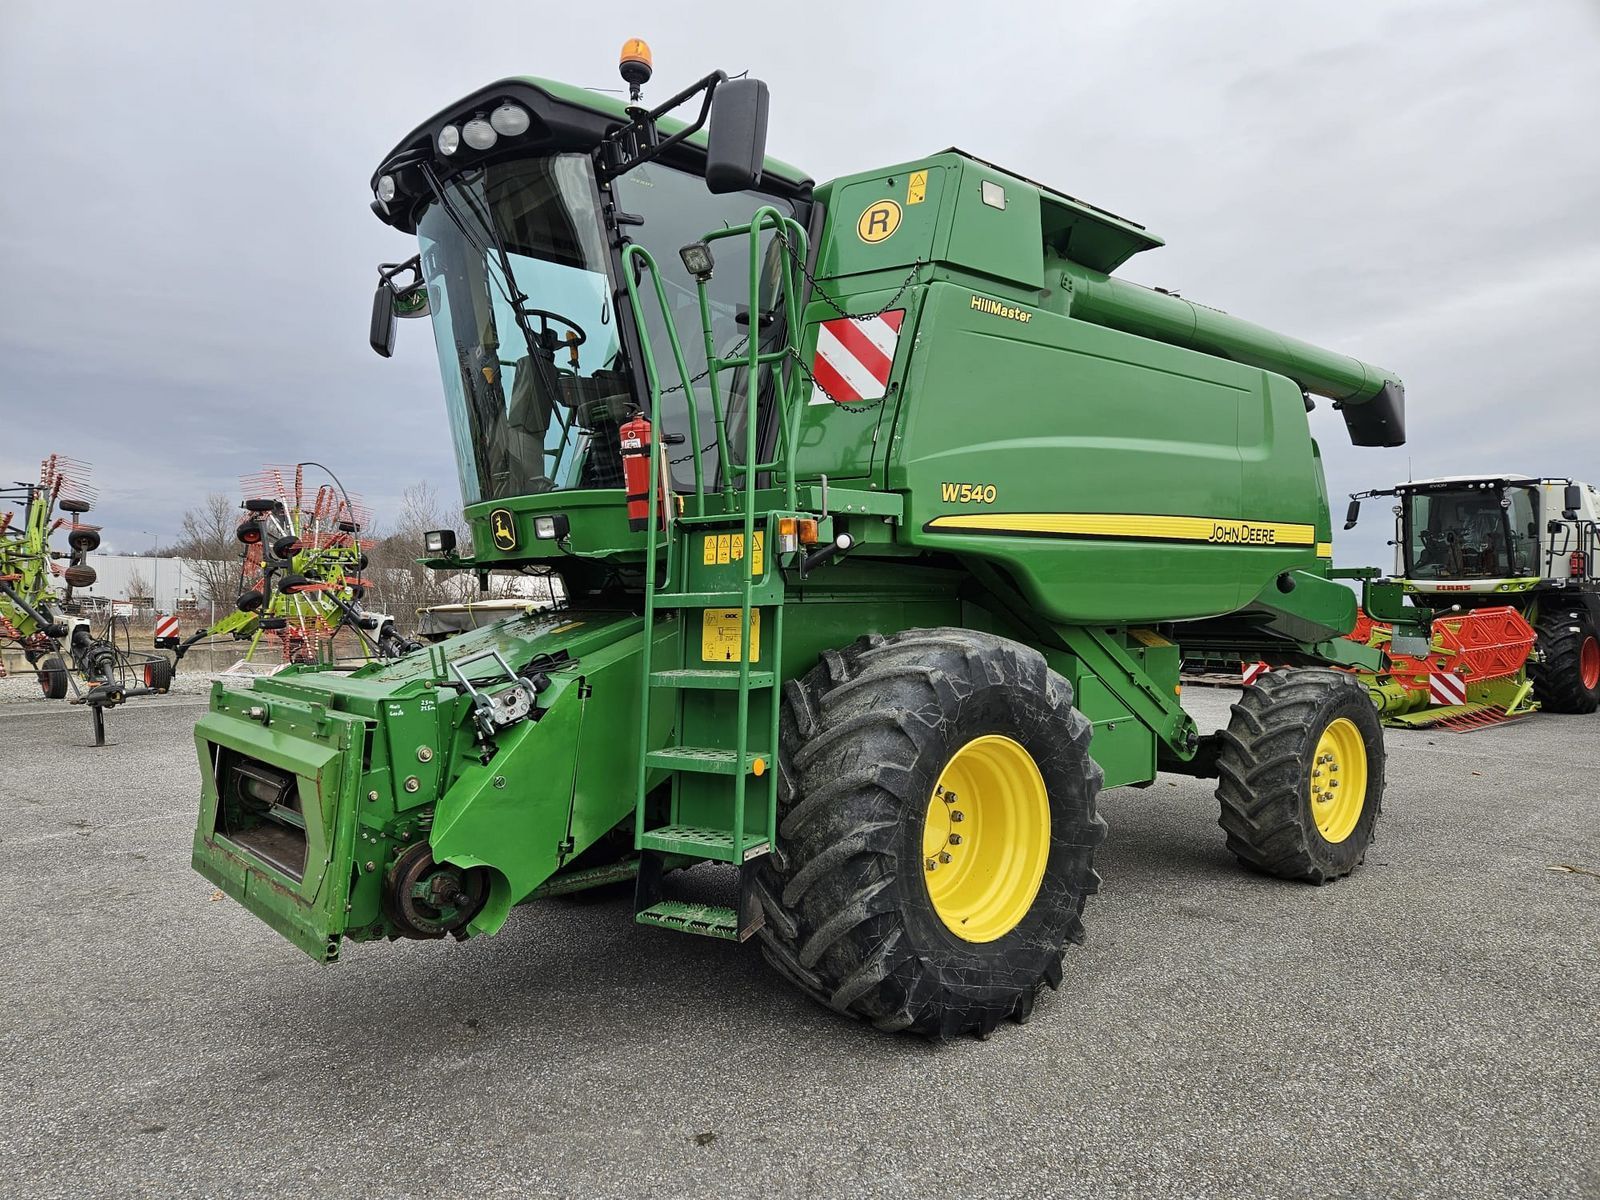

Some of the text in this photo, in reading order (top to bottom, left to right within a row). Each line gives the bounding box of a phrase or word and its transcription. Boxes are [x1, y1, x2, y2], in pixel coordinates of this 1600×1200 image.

[868, 209, 890, 235] R
[970, 295, 1032, 323] HillMaster
[941, 482, 997, 504] W540
[1208, 523, 1276, 543] JOHN DEERE
